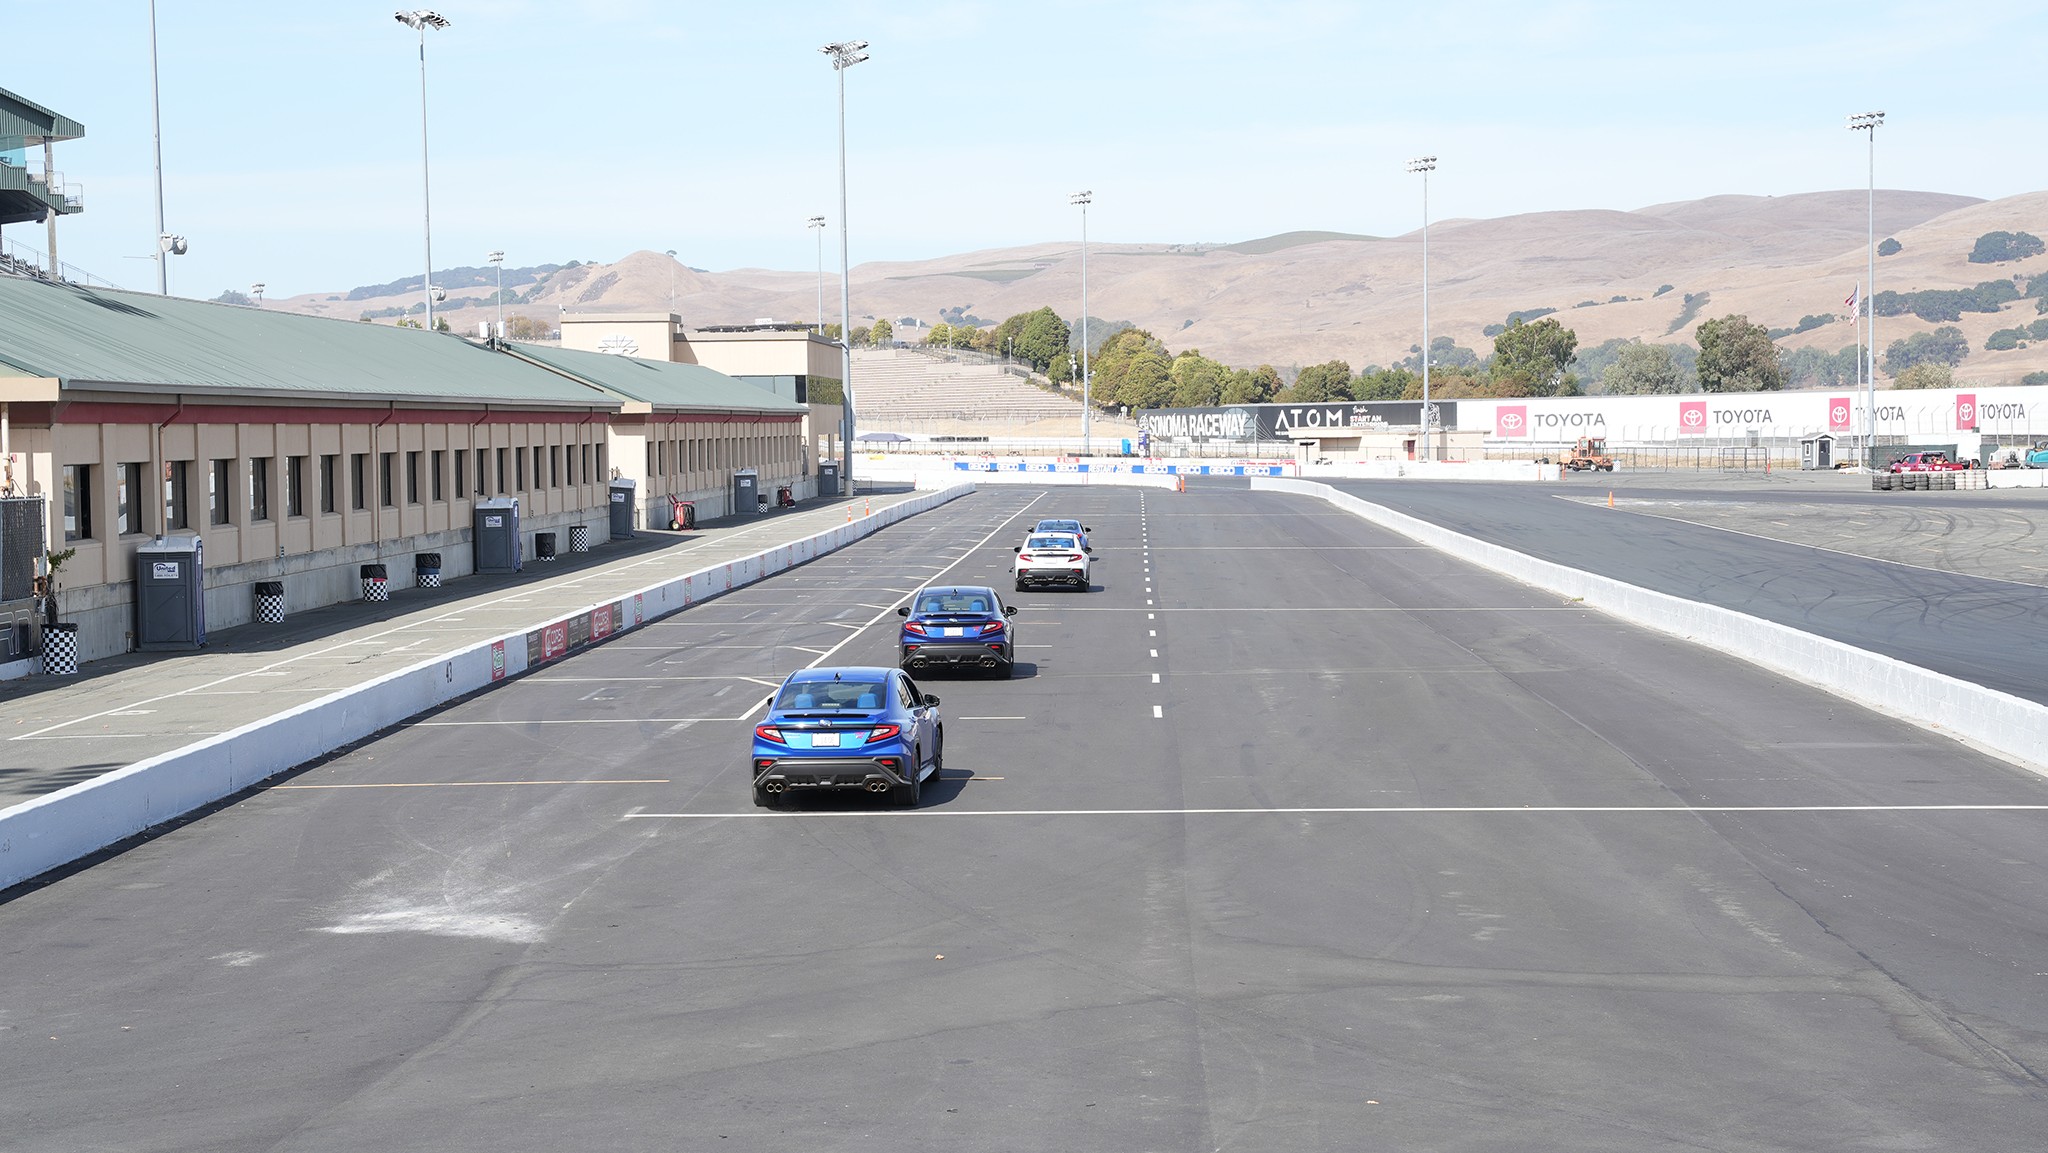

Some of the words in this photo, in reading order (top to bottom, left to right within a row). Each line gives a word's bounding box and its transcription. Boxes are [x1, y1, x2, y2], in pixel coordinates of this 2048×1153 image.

[1713, 409, 1773, 424] TOYOTA
[1980, 403, 2026, 419] TOYOTA
[1149, 413, 1189, 437] SONOMA
[1189, 413, 1247, 436] RACEWAY
[1534, 413, 1605, 427] TOYOTA
